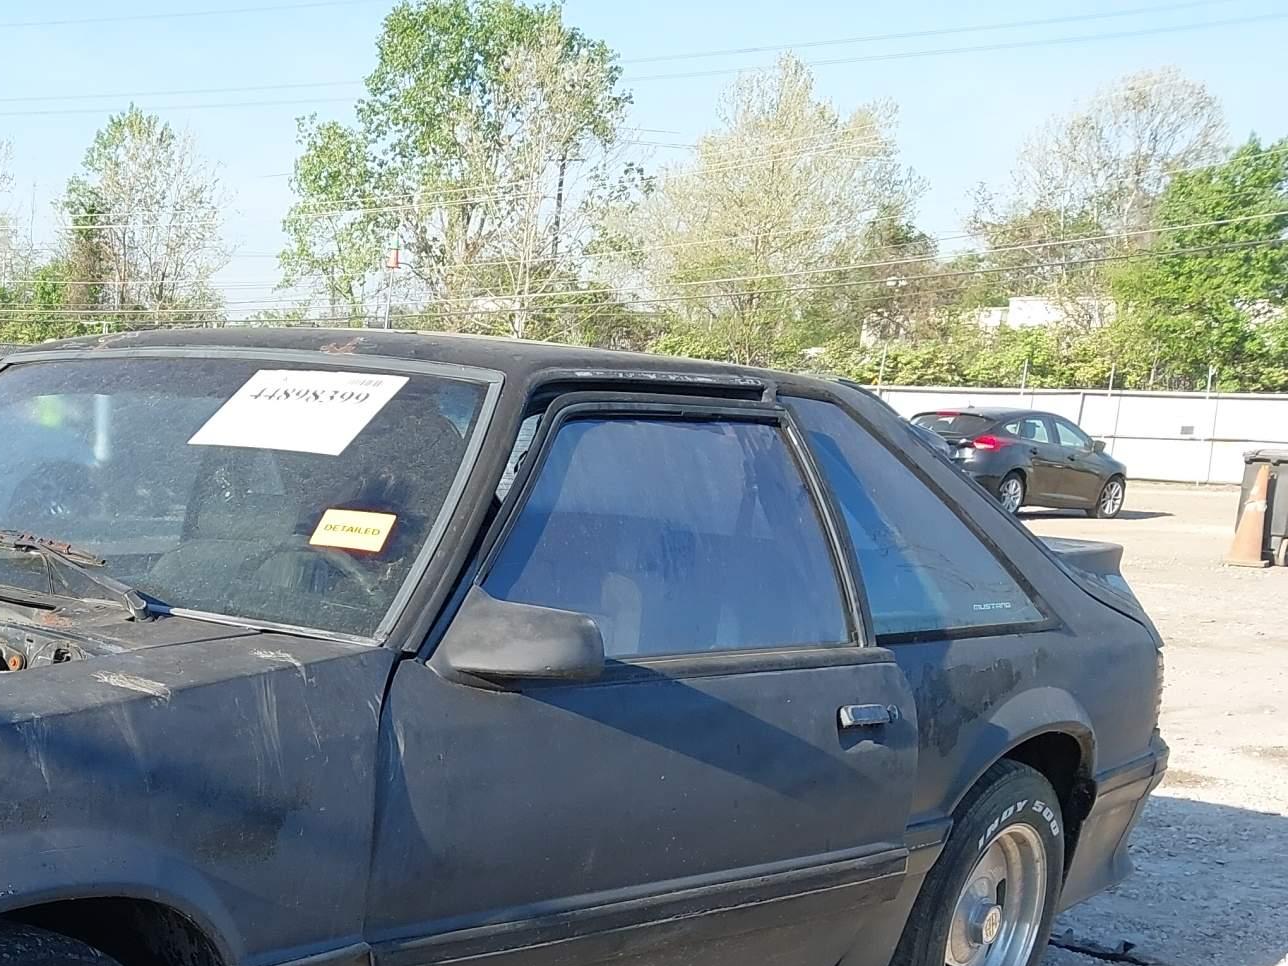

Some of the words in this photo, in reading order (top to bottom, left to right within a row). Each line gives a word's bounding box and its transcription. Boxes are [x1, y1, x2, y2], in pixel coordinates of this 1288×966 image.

[250, 387, 370, 403] 44898399
[323, 524, 380, 536] DETAILED
[973, 602, 1012, 611] MUSTANG
[978, 799, 1028, 850] INDY
[1032, 800, 1059, 836] 500
